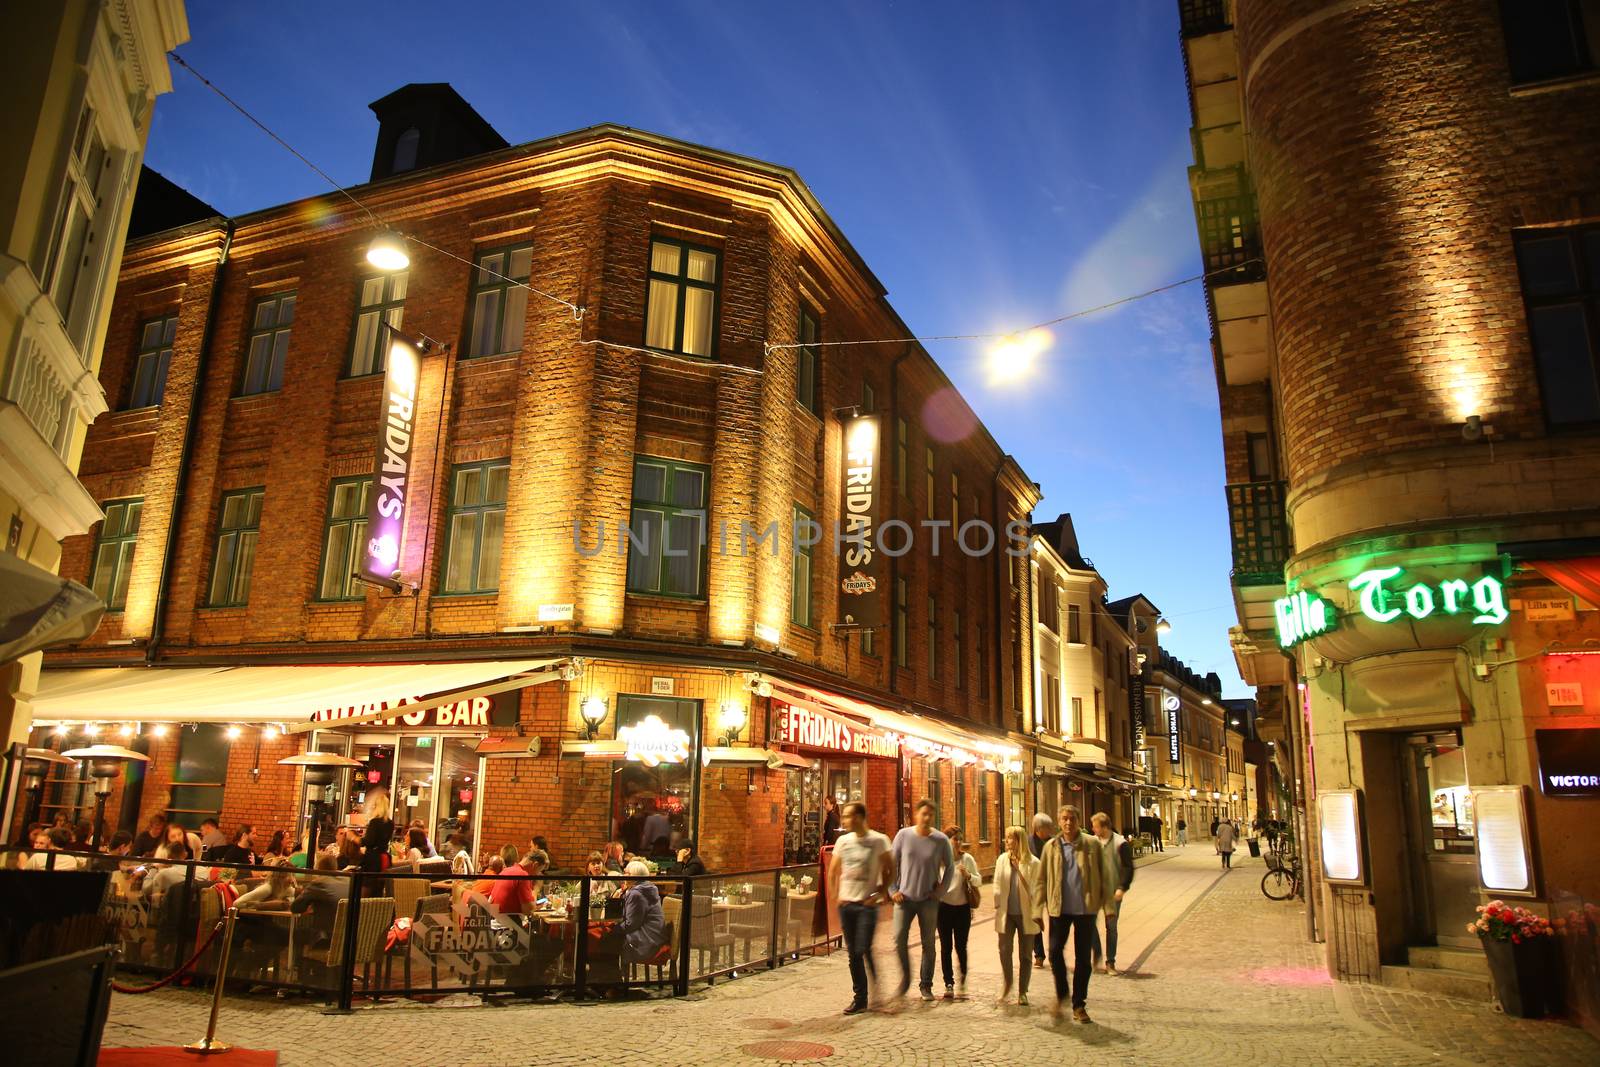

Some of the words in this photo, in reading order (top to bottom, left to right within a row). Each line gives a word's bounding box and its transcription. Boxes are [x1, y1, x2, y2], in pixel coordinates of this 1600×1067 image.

[1349, 566, 1509, 625] Torg
[1527, 601, 1547, 610] Lilla
[1550, 601, 1569, 610] torg
[435, 696, 491, 726] BAR
[1133, 681, 1144, 746] RENAISSANCE
[1170, 711, 1178, 734] JOHAN
[853, 732, 899, 759] RESTAURANT
[1549, 775, 1600, 787] VICTOR
